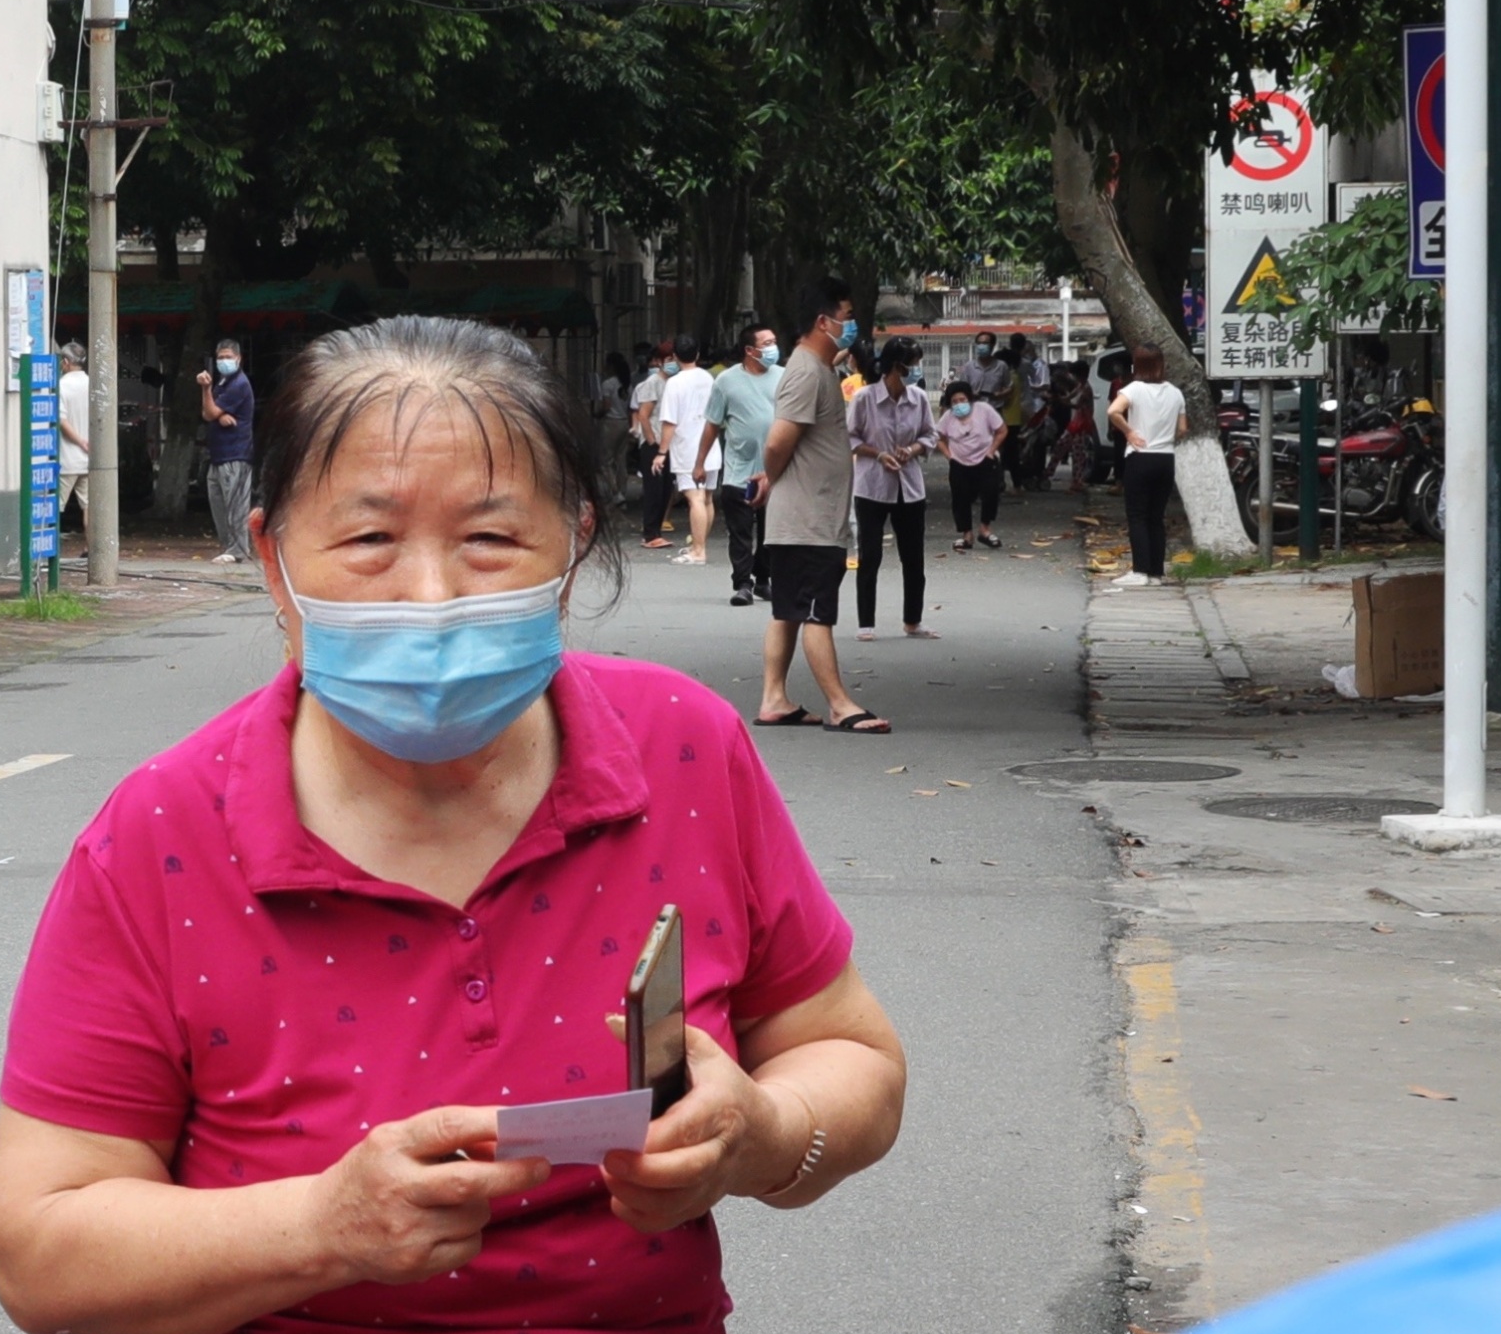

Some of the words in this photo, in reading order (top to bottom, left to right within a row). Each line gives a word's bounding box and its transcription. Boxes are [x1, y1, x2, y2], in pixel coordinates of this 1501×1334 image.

[1220, 191, 1313, 216] 禁鸣喇叭
[1220, 345, 1313, 370] 车辆慢行
